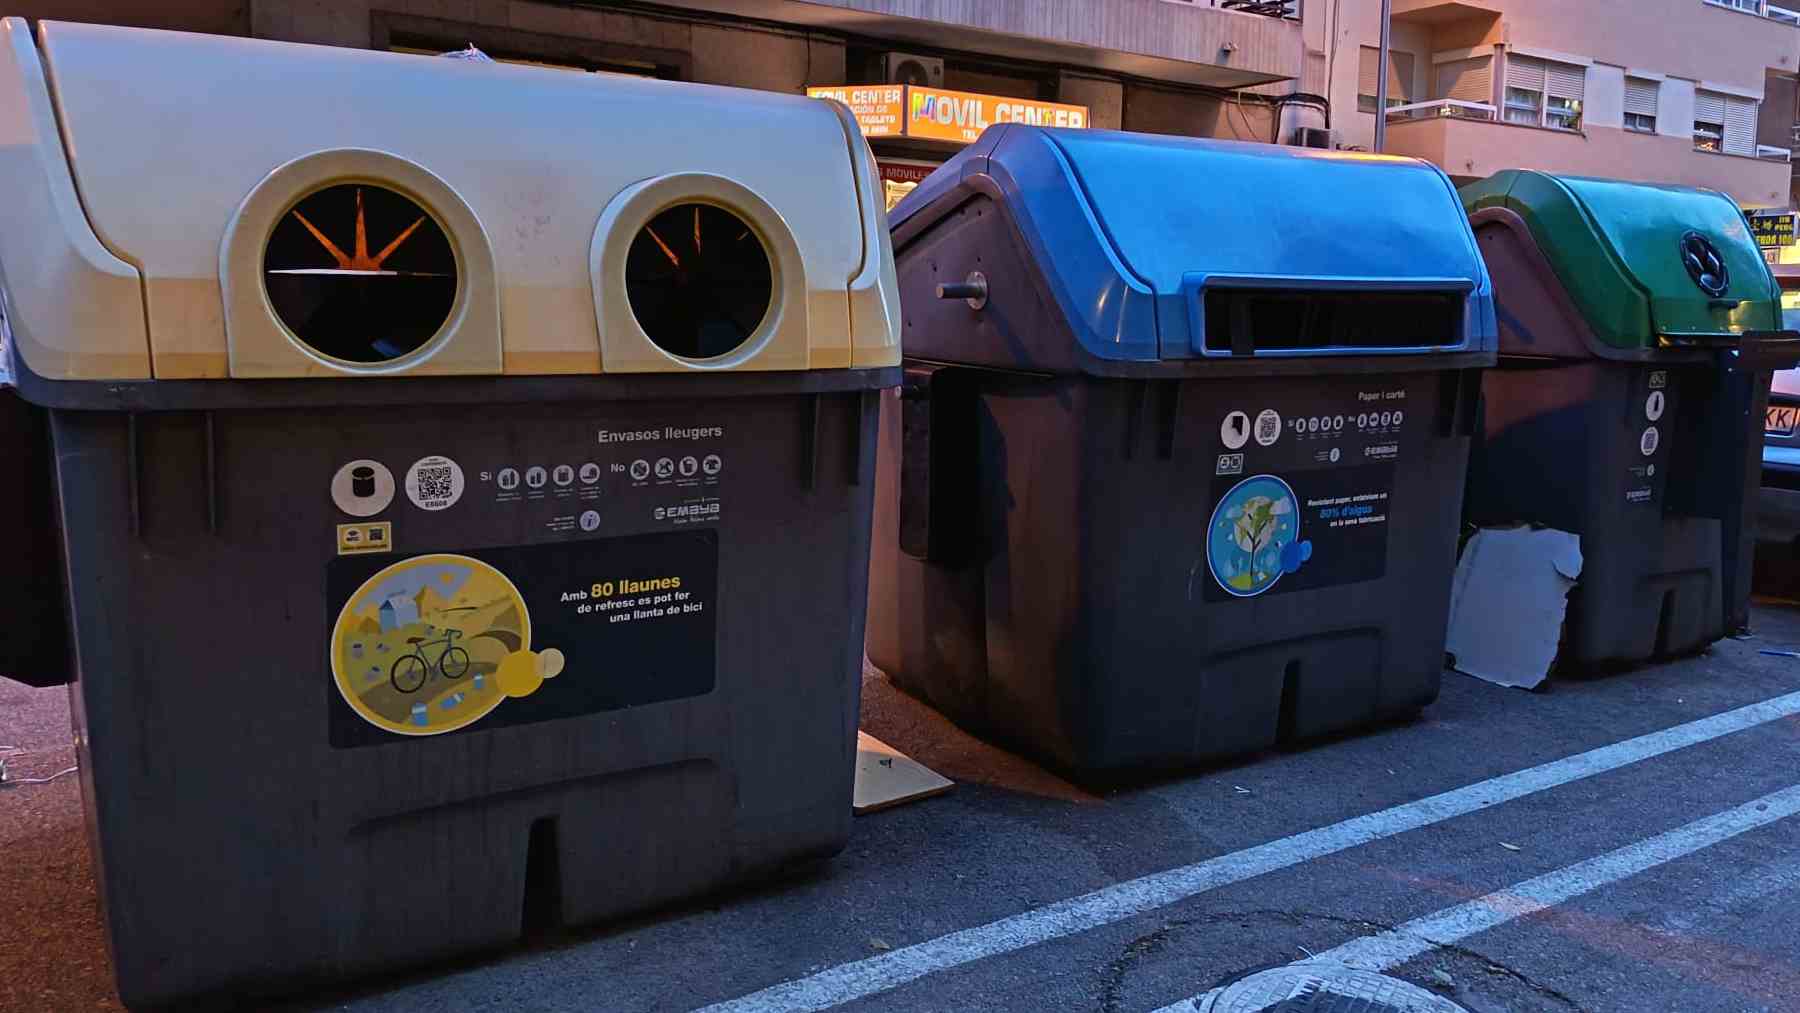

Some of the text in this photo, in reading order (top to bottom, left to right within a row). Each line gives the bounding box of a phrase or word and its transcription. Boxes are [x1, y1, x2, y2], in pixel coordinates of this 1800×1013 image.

[912, 92, 988, 128] MOVIL
[598, 427, 723, 443] Envasos lleugers
[610, 463, 626, 473] No
[560, 576, 681, 602] Amb 80 llaunes
[577, 591, 691, 614] de refresc es pot fer
[610, 602, 703, 623] una llanta de bici
